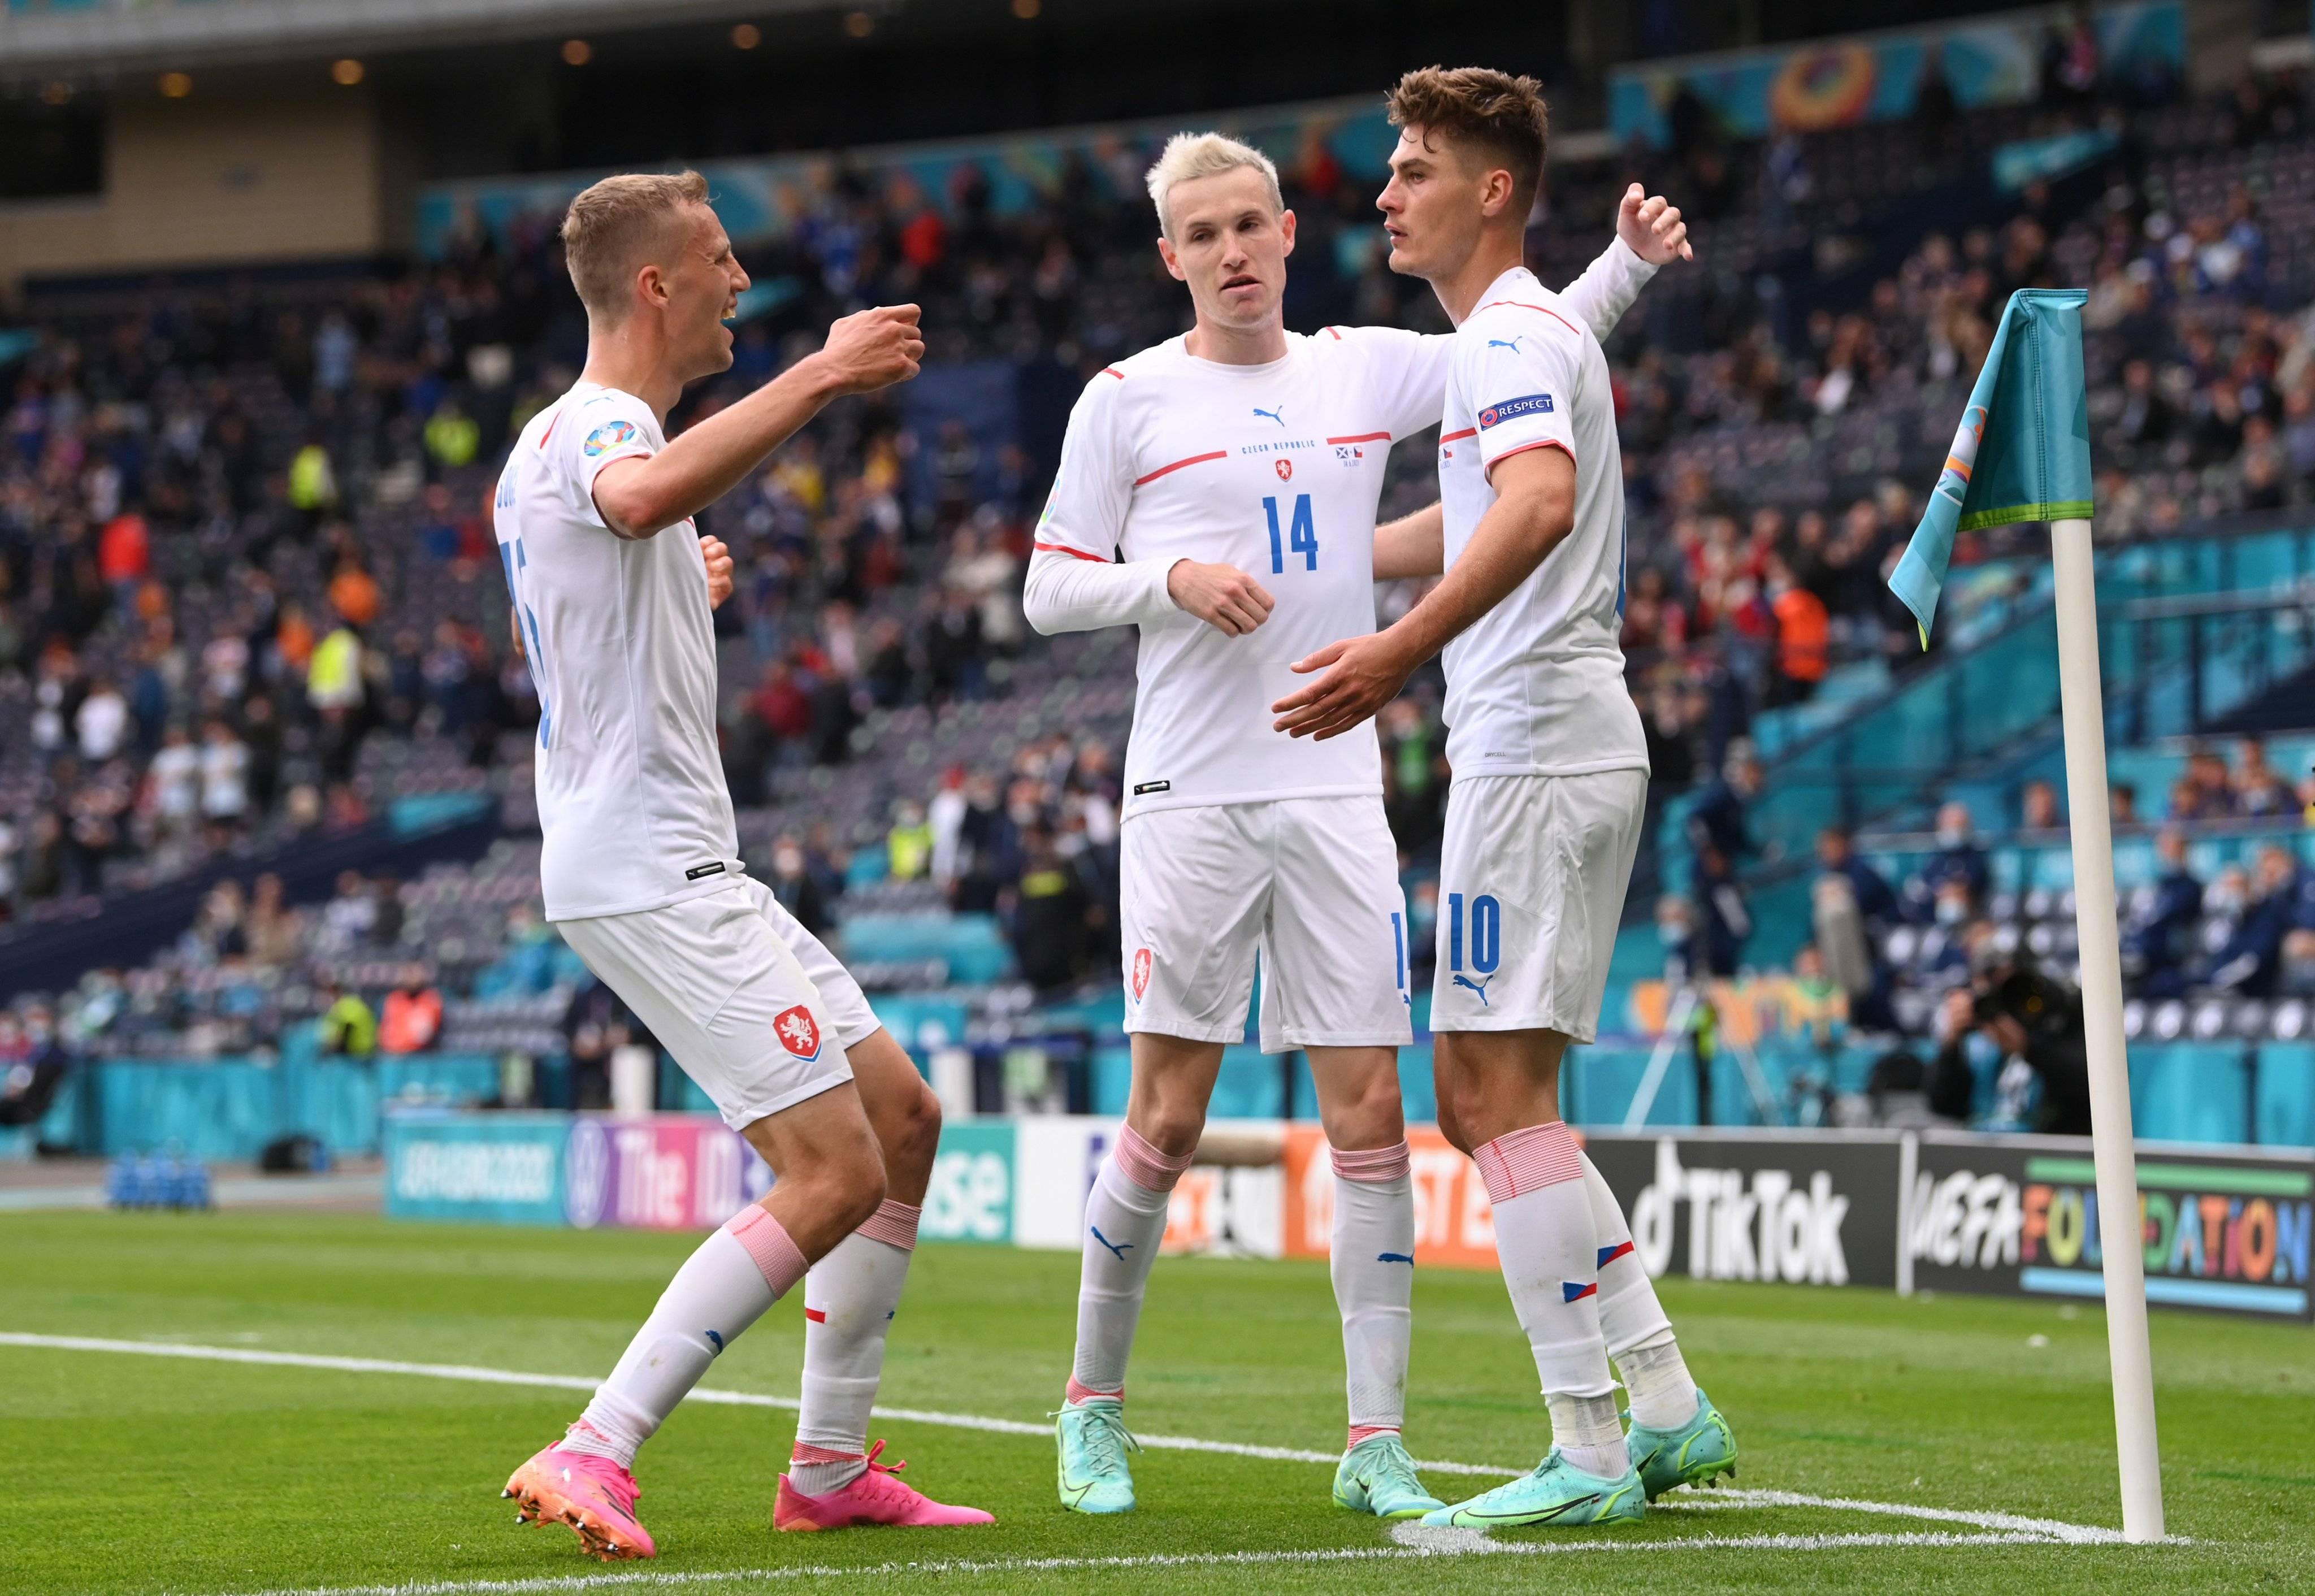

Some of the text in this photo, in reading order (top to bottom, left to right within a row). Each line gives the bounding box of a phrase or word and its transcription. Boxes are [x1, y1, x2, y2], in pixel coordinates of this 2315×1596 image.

[1242, 440, 1315, 454] CZECH REPUBLIC
[1499, 399, 1551, 417] RESPECT
[1262, 493, 1319, 574] 14
[1391, 912, 1411, 989] 1
[1449, 892, 1500, 974] 10
[1687, 1168, 1851, 1287] TikTok
